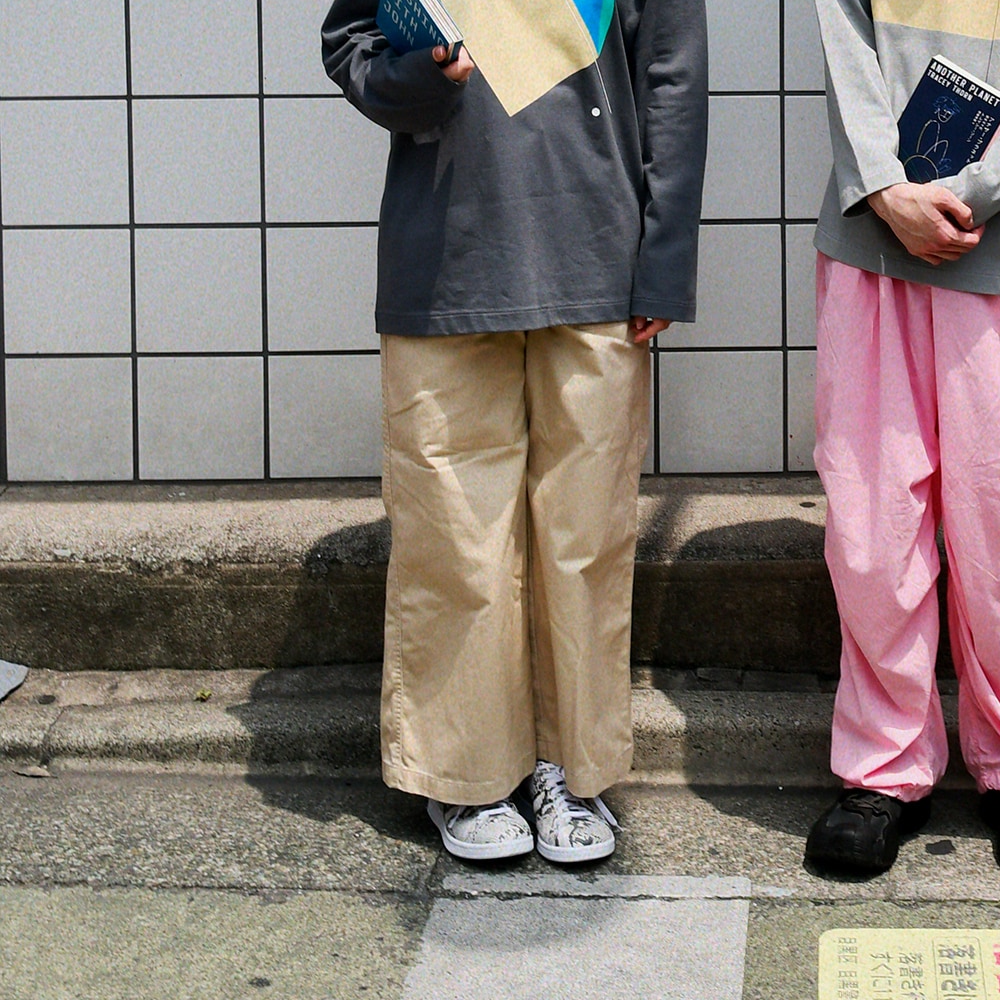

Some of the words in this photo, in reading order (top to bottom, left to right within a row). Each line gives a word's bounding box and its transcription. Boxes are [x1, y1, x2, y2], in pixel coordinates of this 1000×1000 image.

[384, 1, 414, 46] JOHN
[927, 70, 950, 88] TRACEY
[952, 86, 974, 102] THORN
[930, 62, 967, 87] ANOTHER
[969, 86, 1000, 107] PLANET
